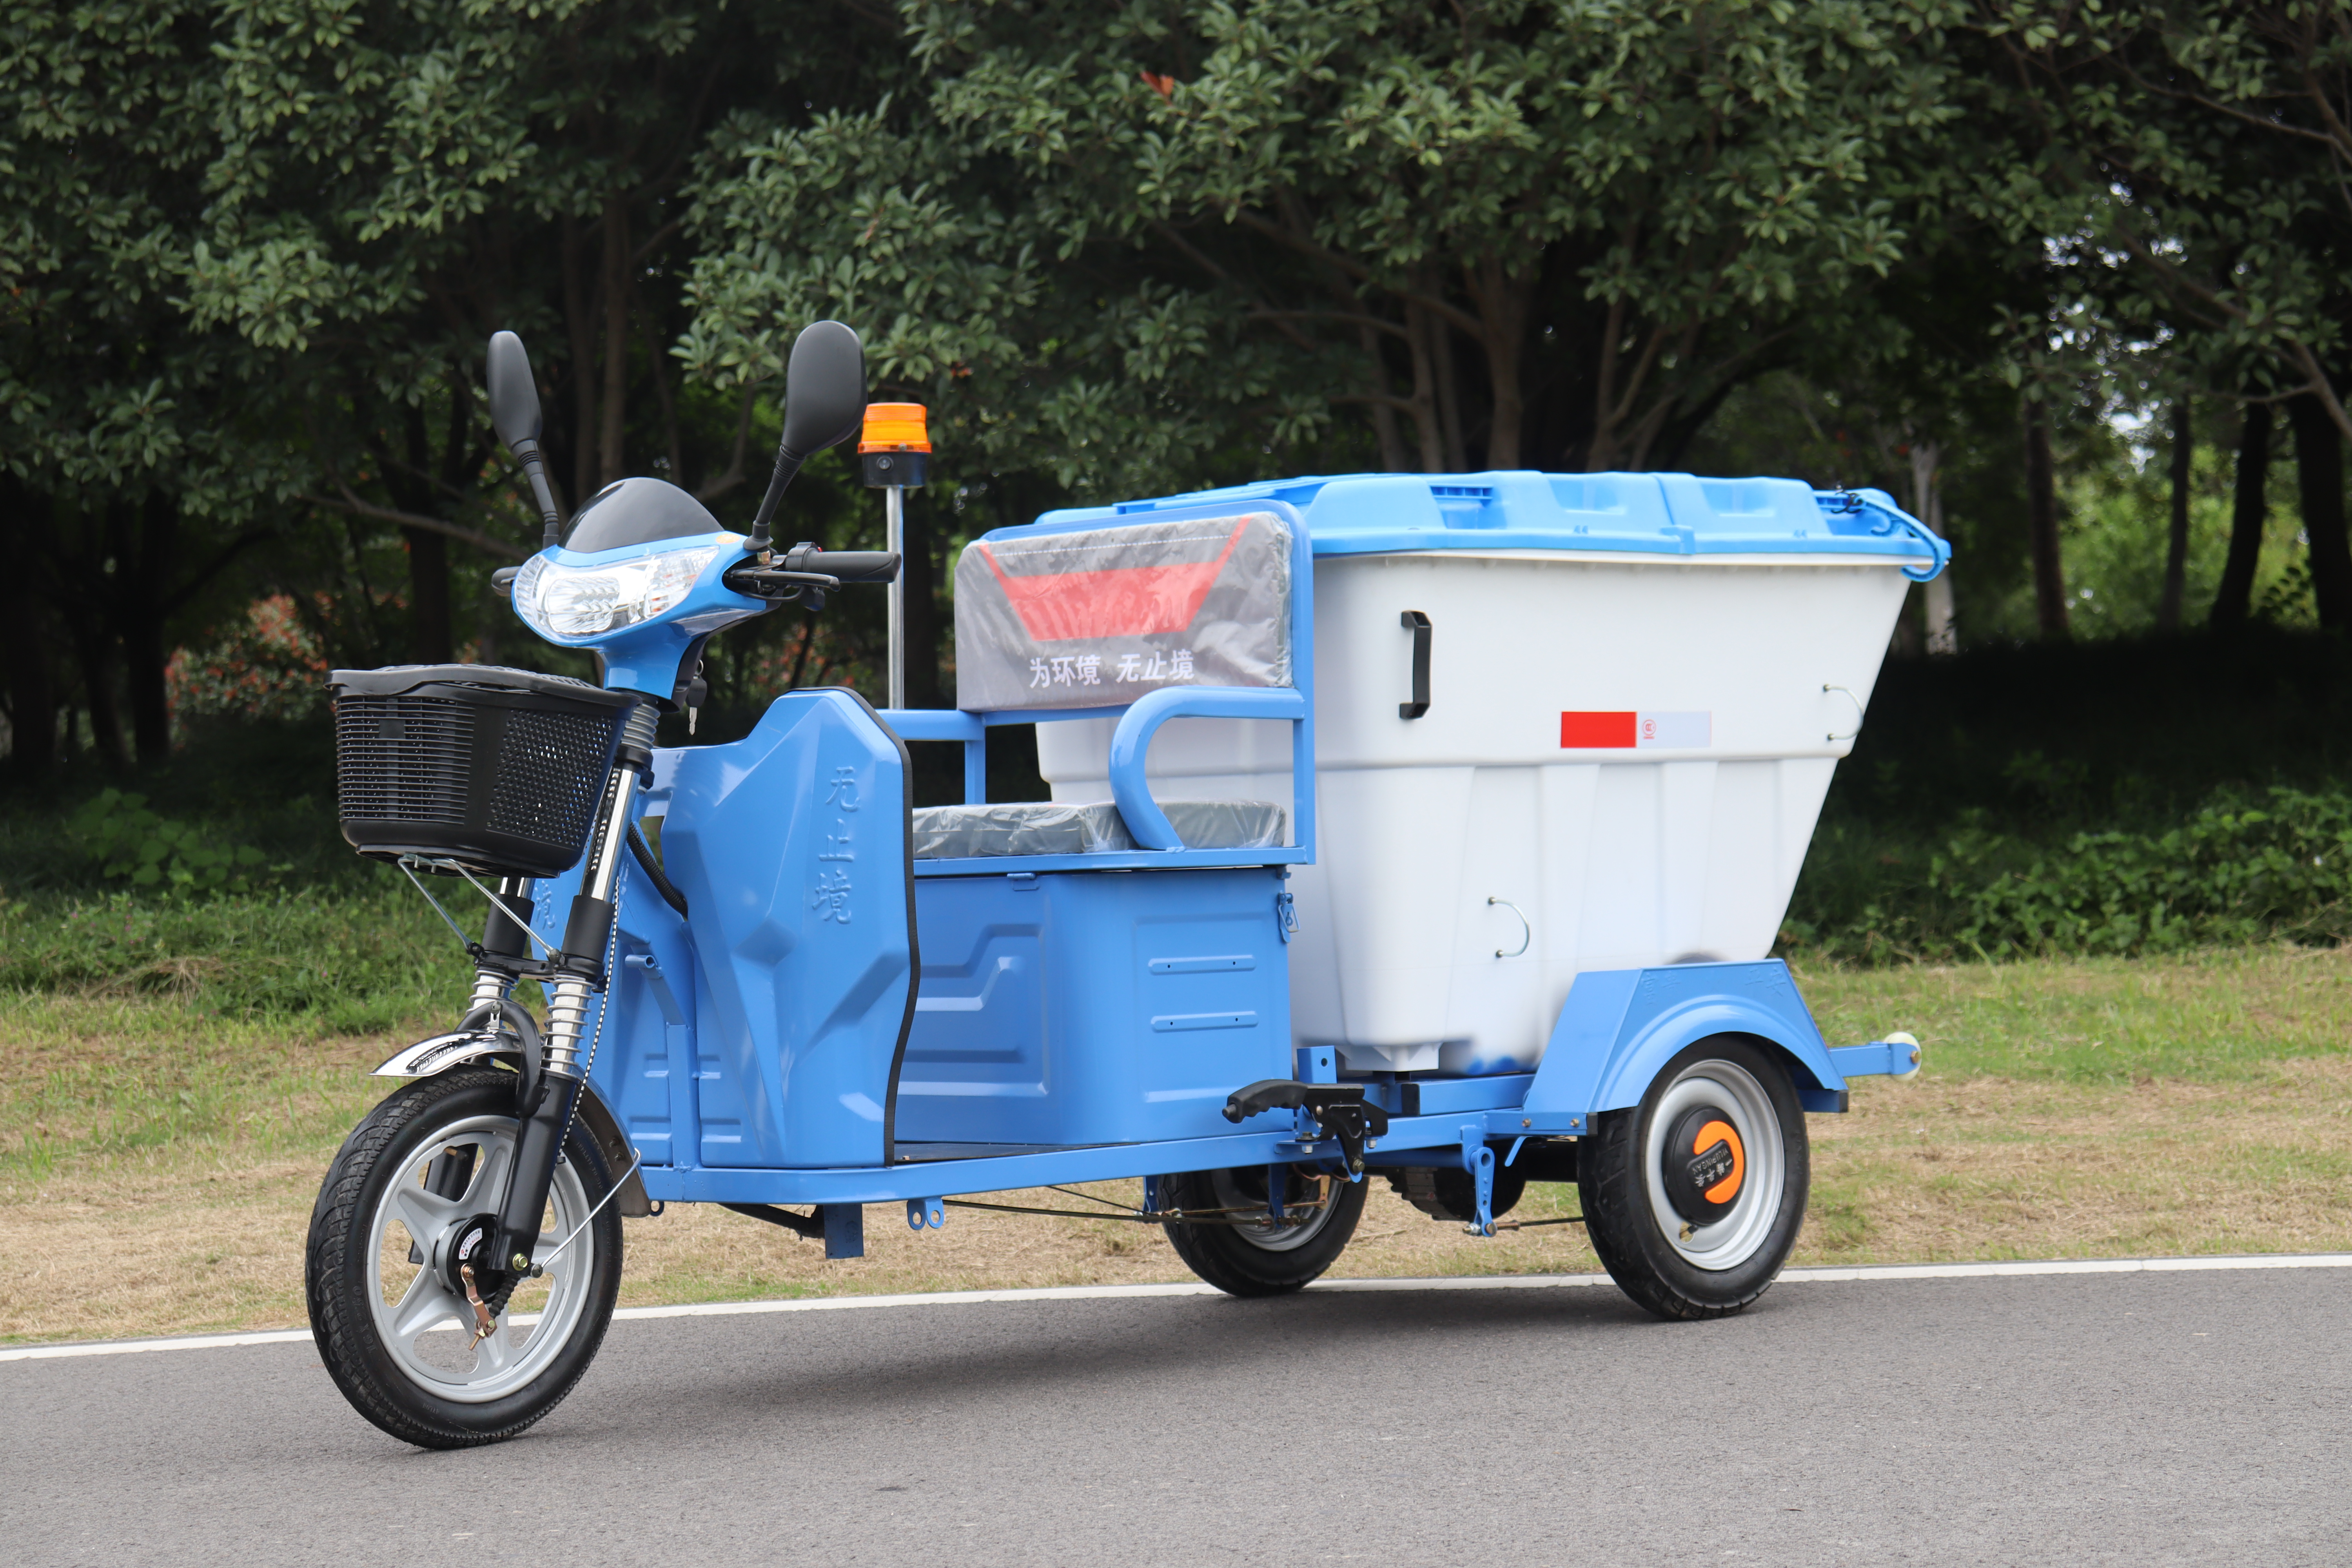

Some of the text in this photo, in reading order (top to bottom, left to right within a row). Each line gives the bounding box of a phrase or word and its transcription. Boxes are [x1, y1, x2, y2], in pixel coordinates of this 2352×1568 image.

[1029, 649, 1195, 689] 为环境 无止境
[812, 766, 861, 925] 无止境
[1692, 1148, 1729, 1174] YILUPINGAN
